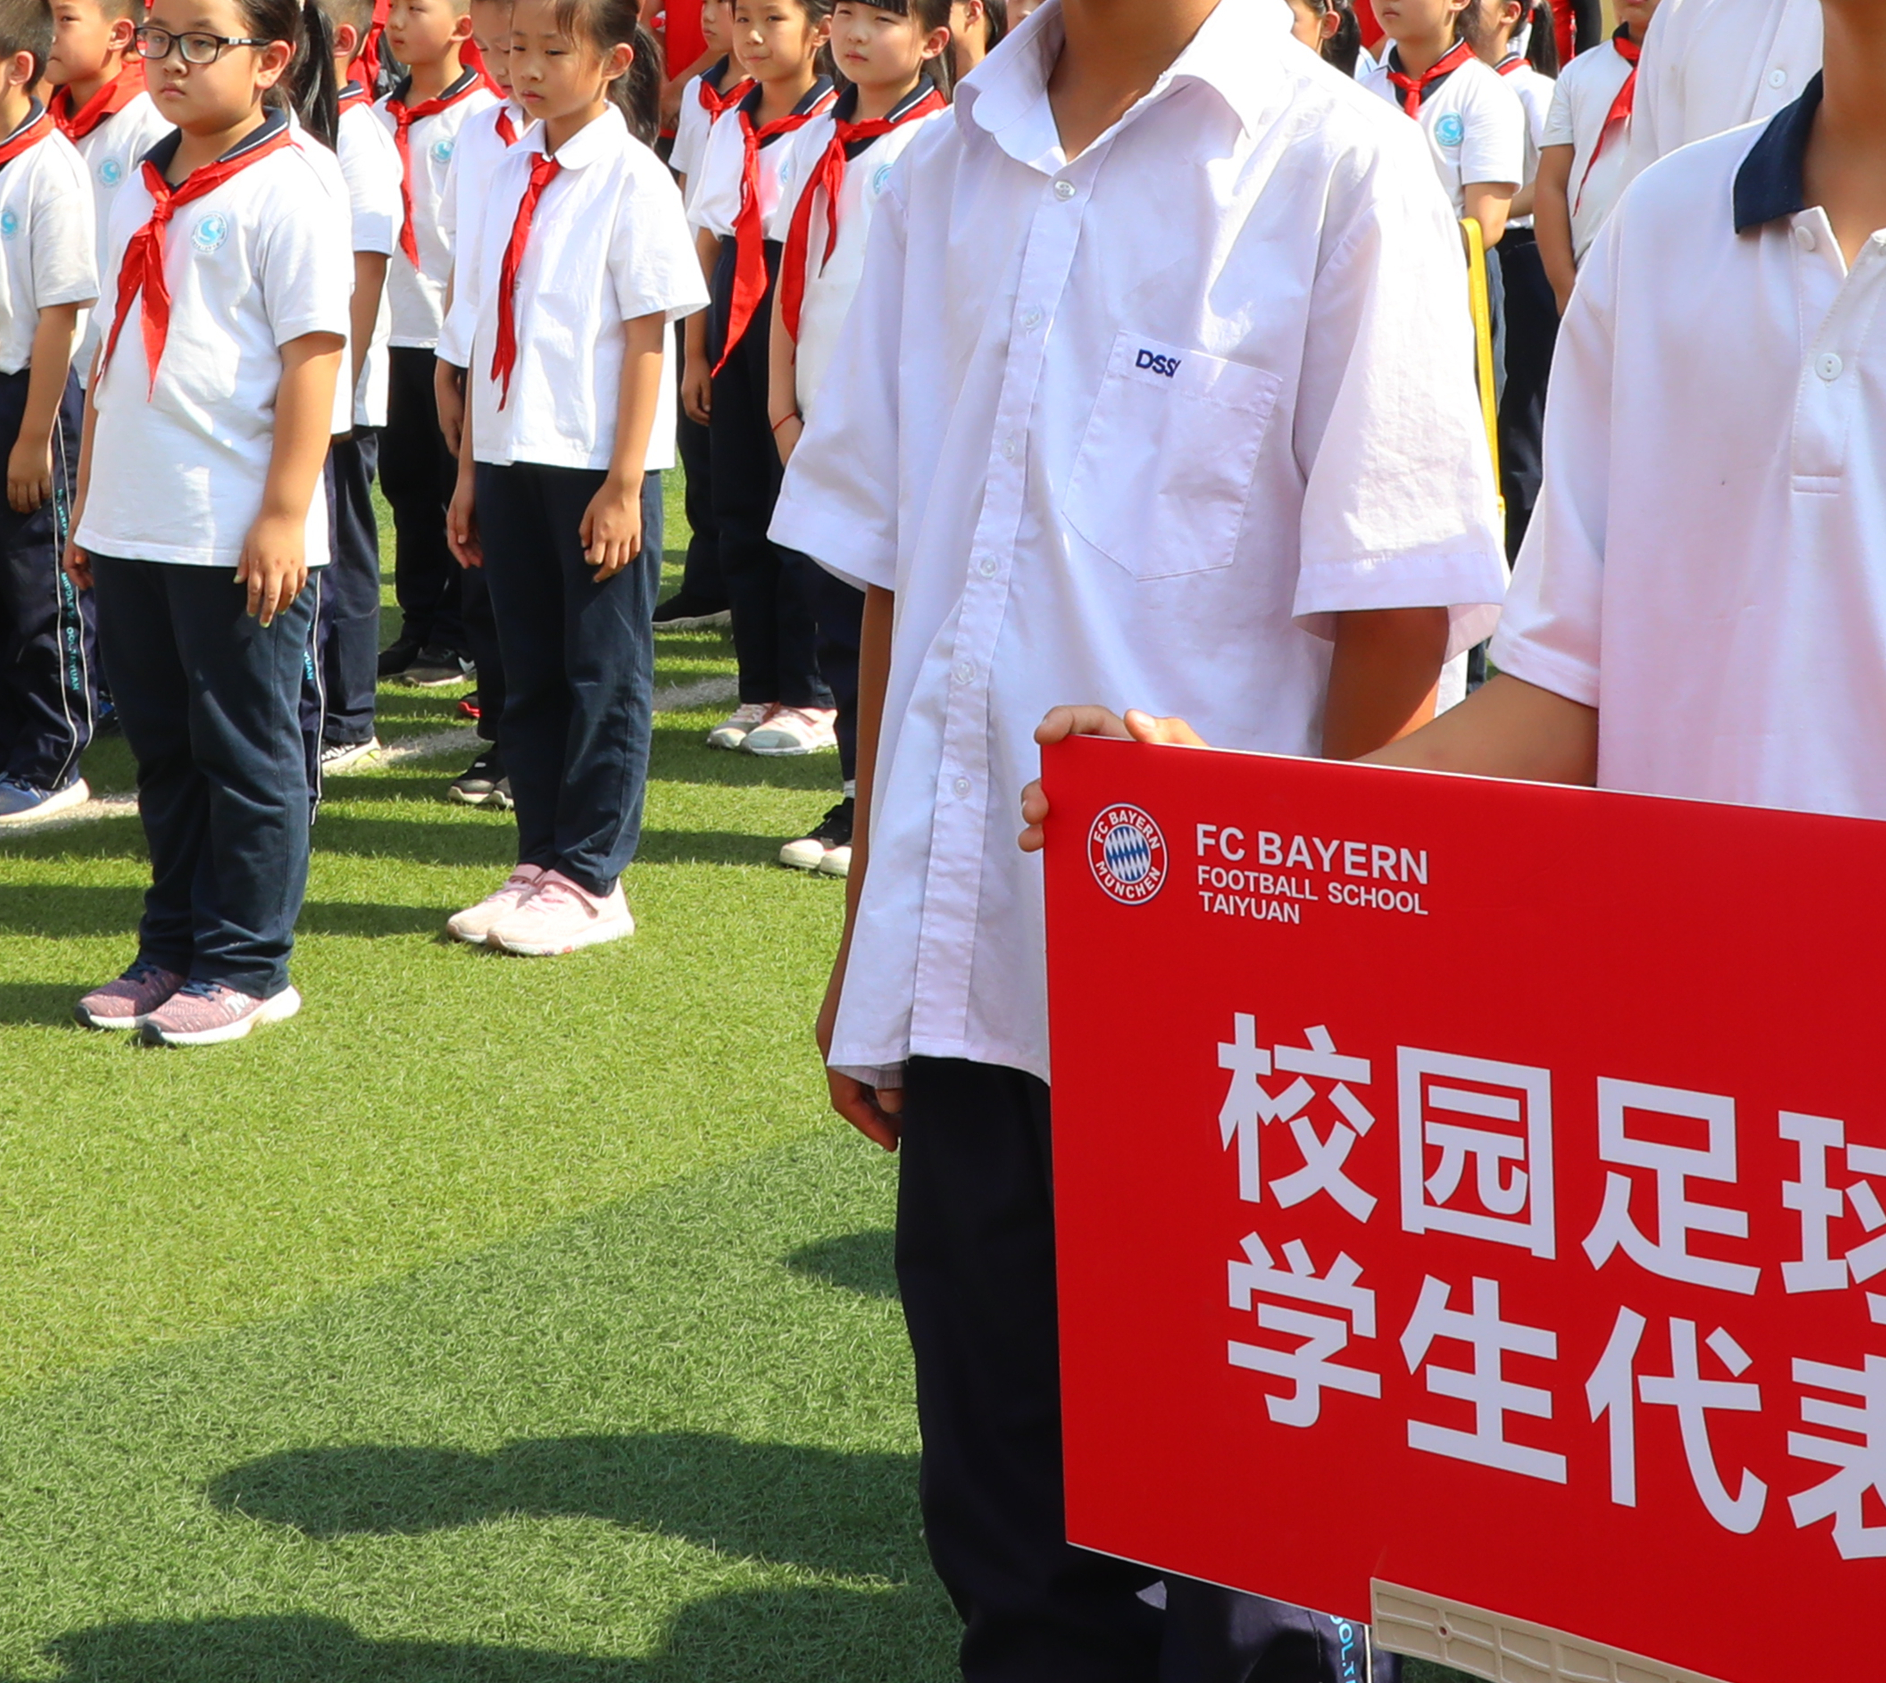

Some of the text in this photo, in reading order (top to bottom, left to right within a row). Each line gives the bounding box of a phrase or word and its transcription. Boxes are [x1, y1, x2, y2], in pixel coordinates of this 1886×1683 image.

[1093, 809, 1161, 850] FC BAYERN
[1196, 823, 1428, 885] FC BAYERN
[1095, 861, 1161, 899] MÜNCHEN
[1197, 865, 1429, 916] FOOTBALL SCHOOL
[1198, 890, 1301, 925] TAIYUAN
